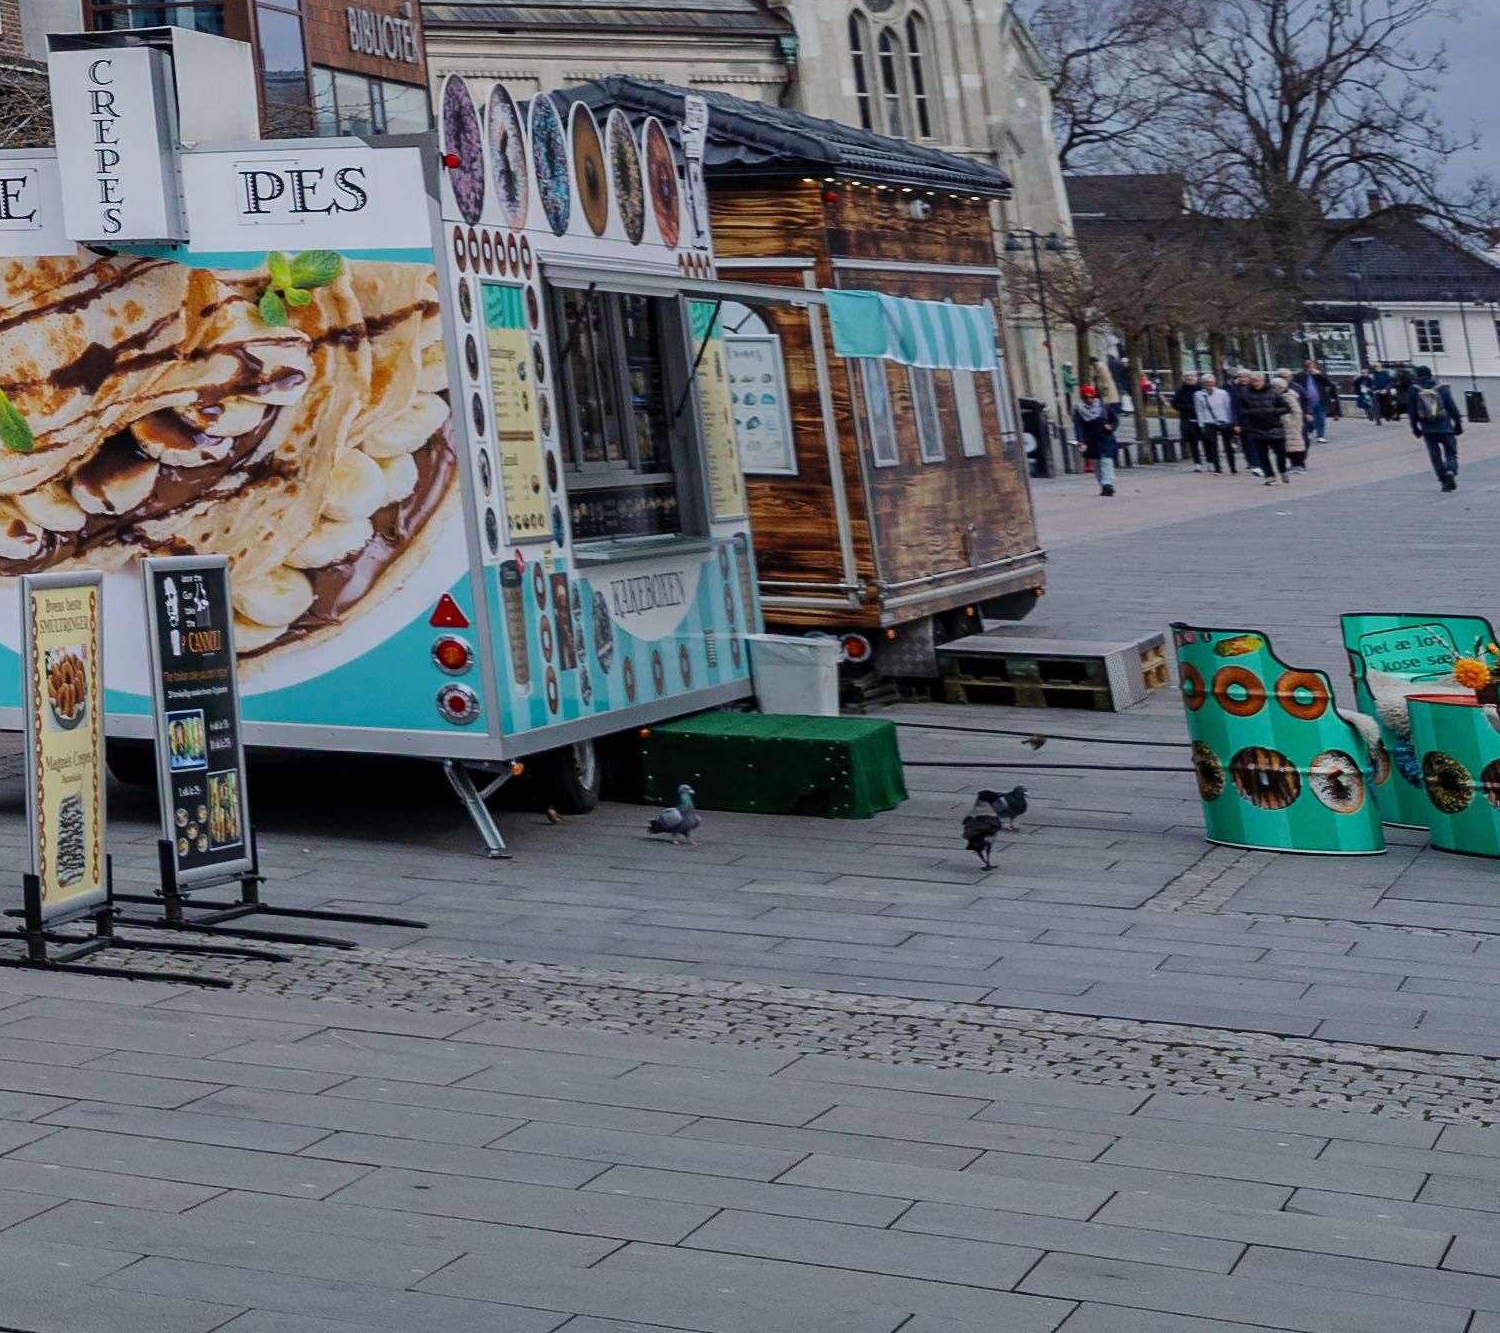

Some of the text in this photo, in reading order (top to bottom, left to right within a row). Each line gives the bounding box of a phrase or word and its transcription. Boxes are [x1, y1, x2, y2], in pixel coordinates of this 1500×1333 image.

[347, 6, 421, 64] BIBLIOTEK
[86, 58, 123, 234] CREPES
[238, 166, 368, 216] PES
[1362, 641, 1391, 657] Det
[1396, 639, 1411, 651] æ
[1382, 658, 1421, 673] kose
